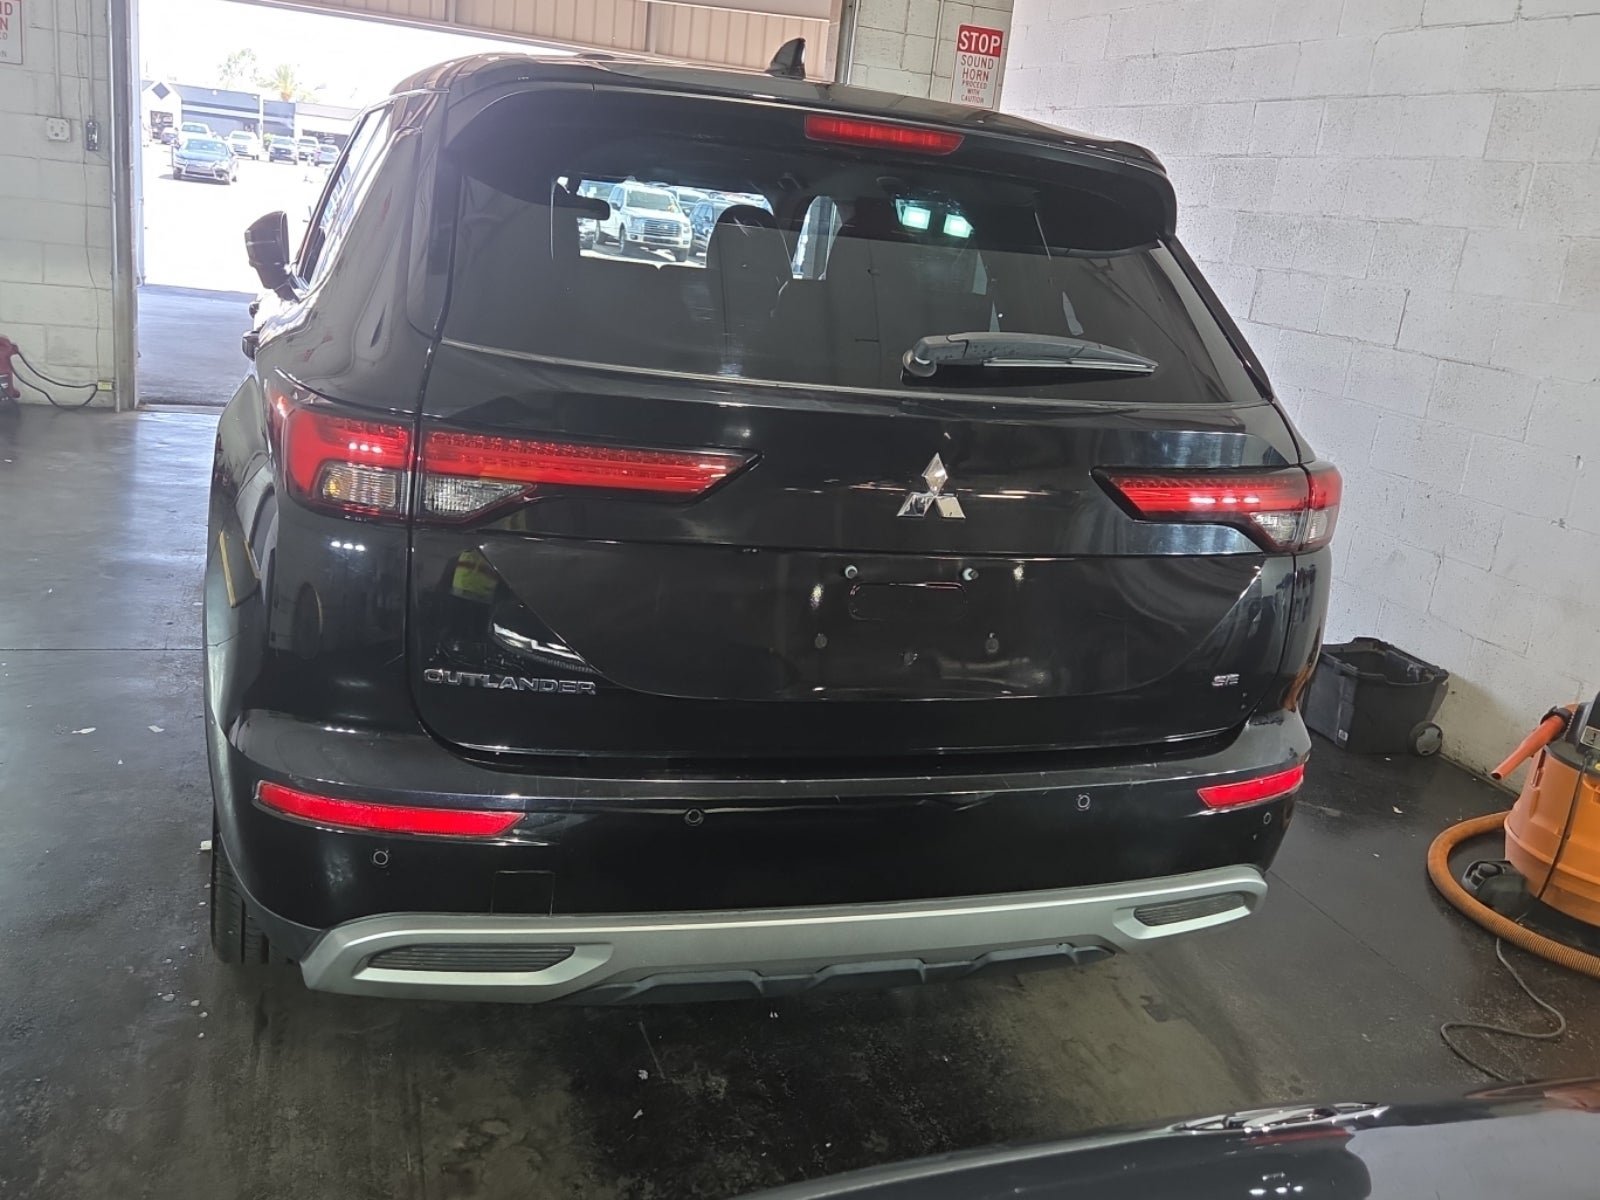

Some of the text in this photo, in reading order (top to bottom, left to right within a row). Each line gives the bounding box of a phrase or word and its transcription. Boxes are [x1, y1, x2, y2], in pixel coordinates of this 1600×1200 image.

[958, 30, 1001, 54] STOP
[960, 54, 994, 70] SOUND
[962, 68, 990, 82] HORN
[962, 80, 988, 90] PROCEED
[961, 94, 985, 104] CAUTION
[423, 668, 597, 696] OUTLANDER
